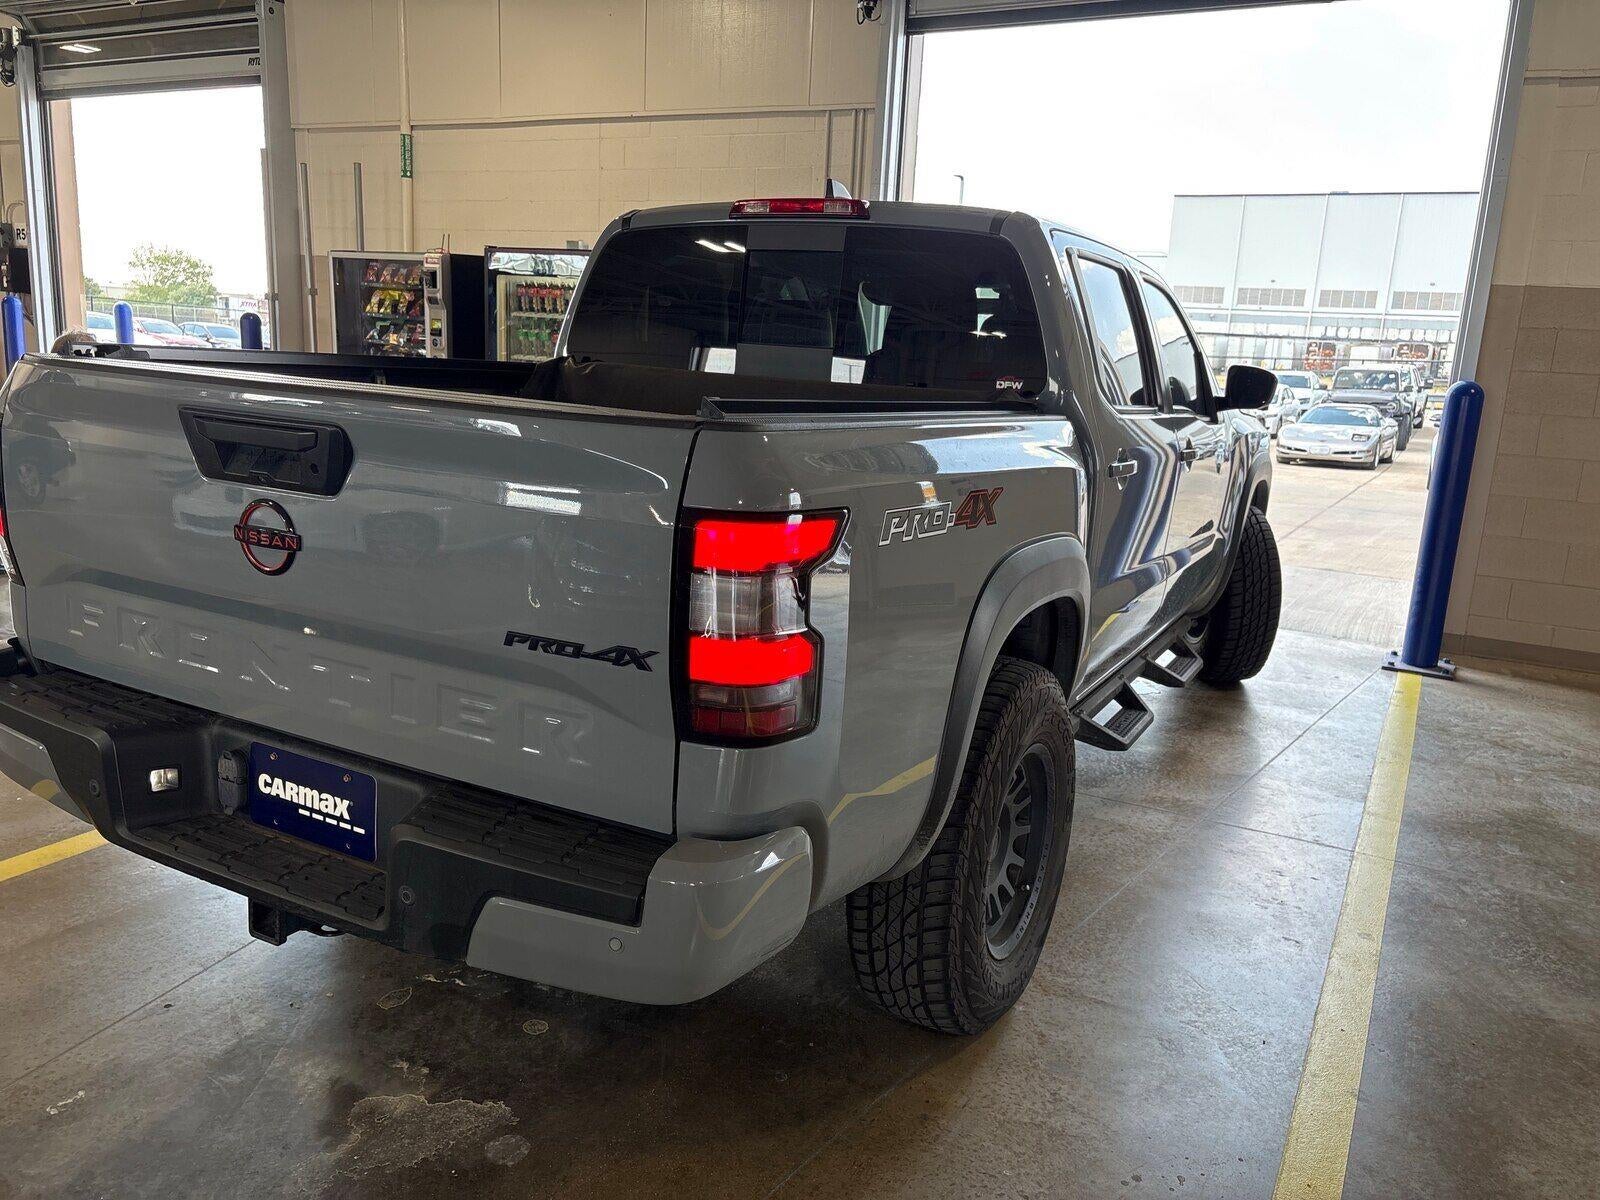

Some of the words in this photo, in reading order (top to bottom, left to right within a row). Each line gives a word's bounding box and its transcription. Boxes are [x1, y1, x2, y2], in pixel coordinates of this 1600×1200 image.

[16, 228, 26, 240] R5
[995, 380, 1023, 390] DFW
[878, 487, 1004, 547] PRO-4X
[235, 527, 297, 549] NISSAN
[503, 630, 660, 672] PRO-4X
